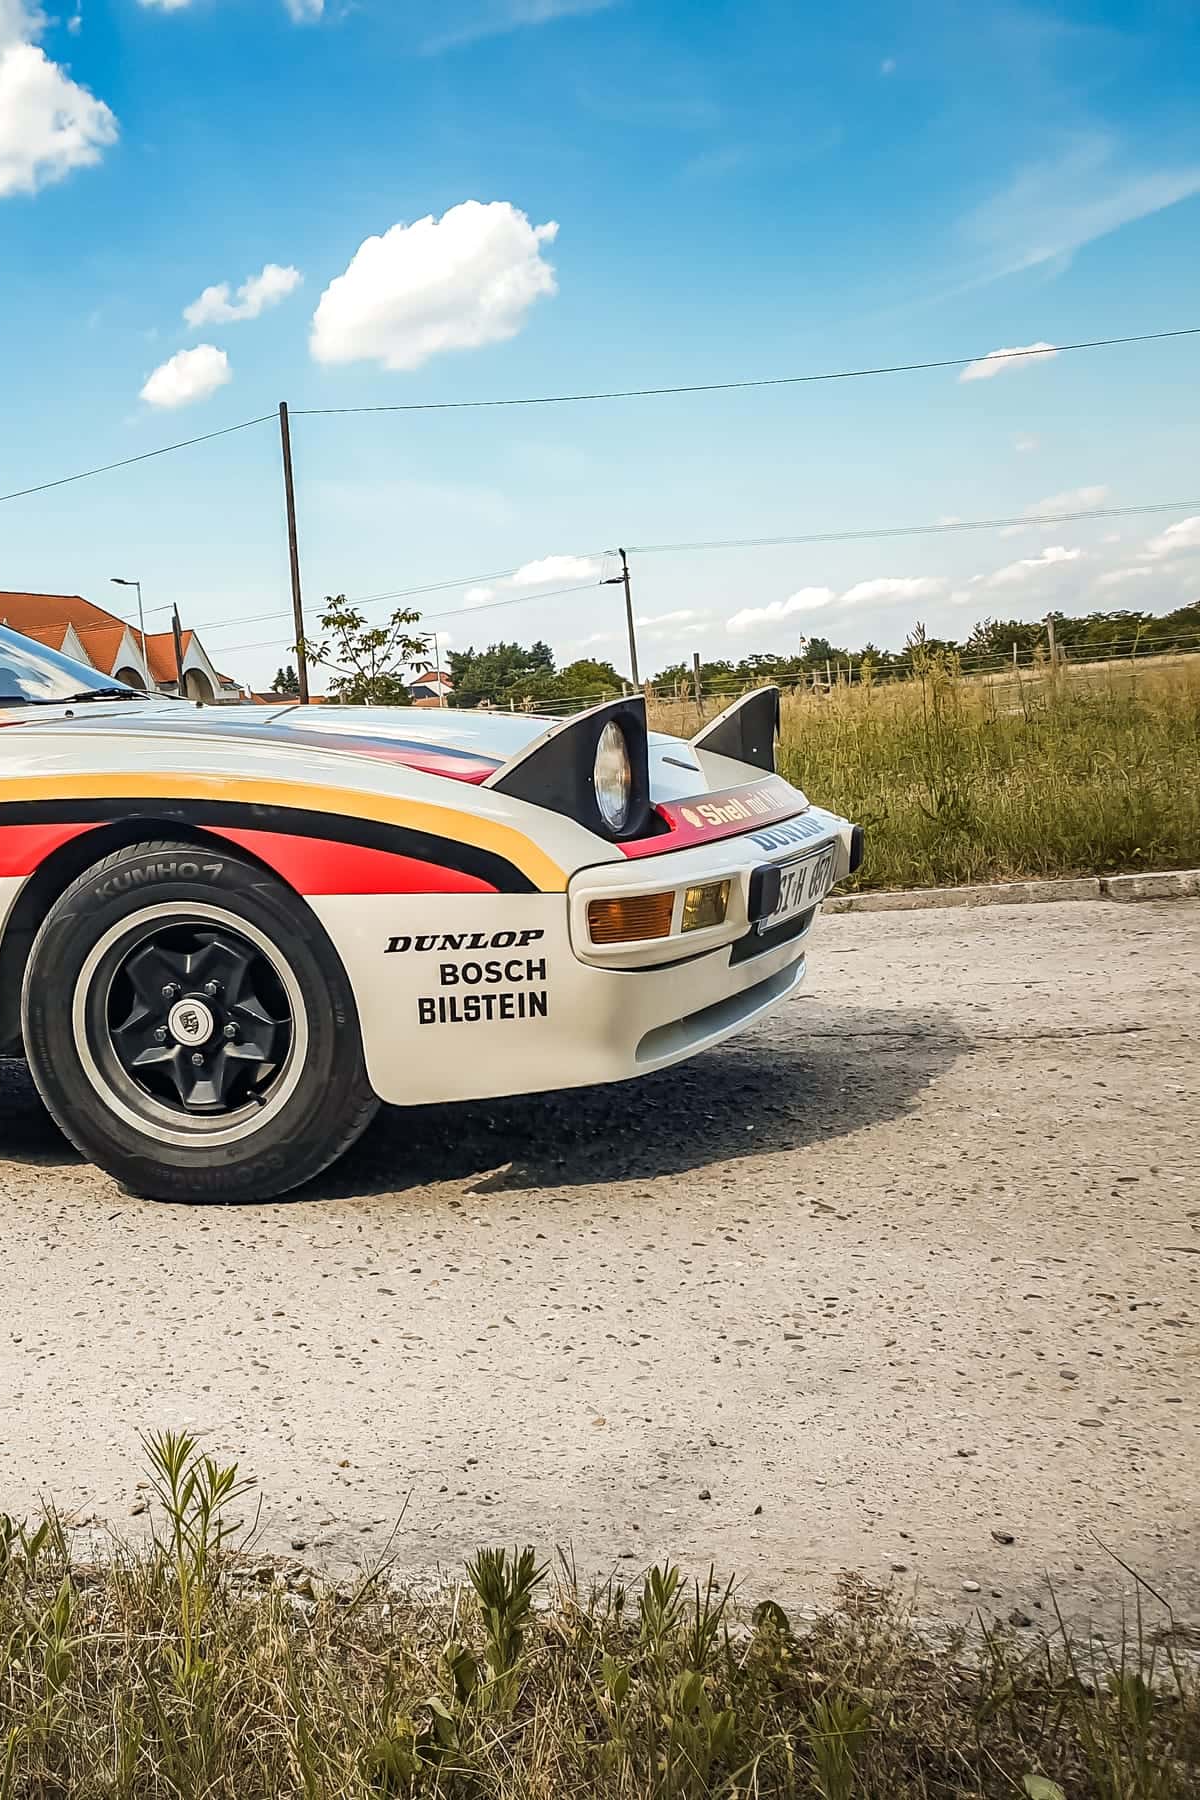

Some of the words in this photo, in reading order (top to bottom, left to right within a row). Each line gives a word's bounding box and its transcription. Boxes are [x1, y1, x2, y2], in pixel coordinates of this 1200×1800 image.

[697, 798, 751, 827] Shell
[745, 815, 826, 851] DUNLOP
[95, 862, 200, 899] KUMHO
[384, 929, 545, 953] DUNLOP
[439, 958, 547, 986] BOSCH
[417, 990, 548, 1025] BILSTEIN
